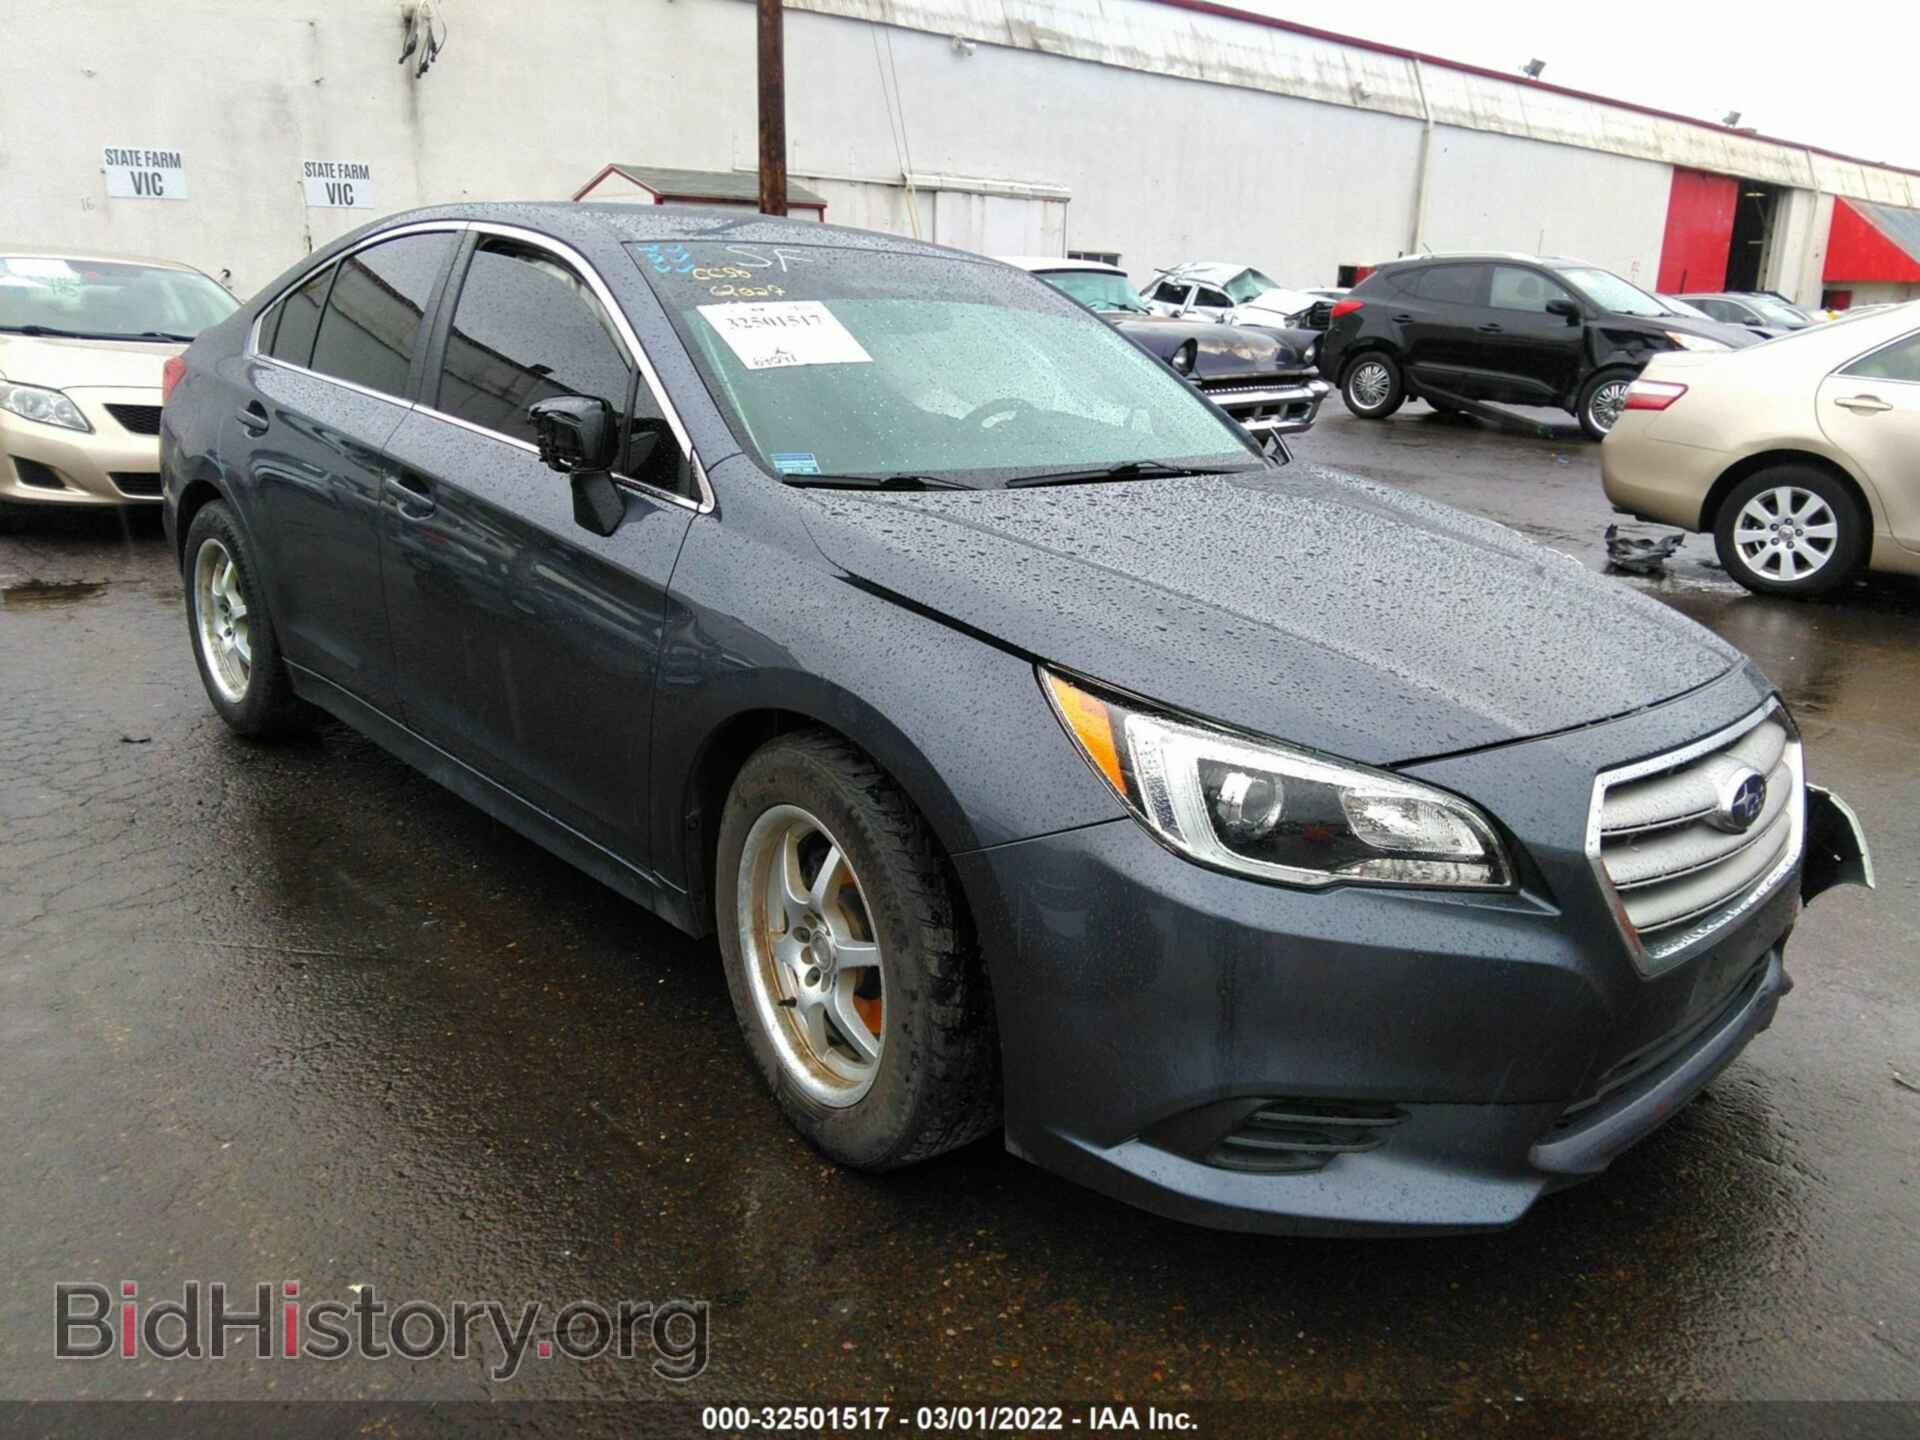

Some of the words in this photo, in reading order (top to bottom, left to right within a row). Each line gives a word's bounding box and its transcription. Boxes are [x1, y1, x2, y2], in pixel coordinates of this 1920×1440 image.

[104, 148, 142, 167] STATE
[145, 150, 182, 169] FARM
[304, 161, 337, 178] STATE
[338, 163, 370, 180] FARM
[130, 171, 164, 196] VIC
[325, 182, 354, 205] VIC
[726, 314, 823, 330] 32501517
